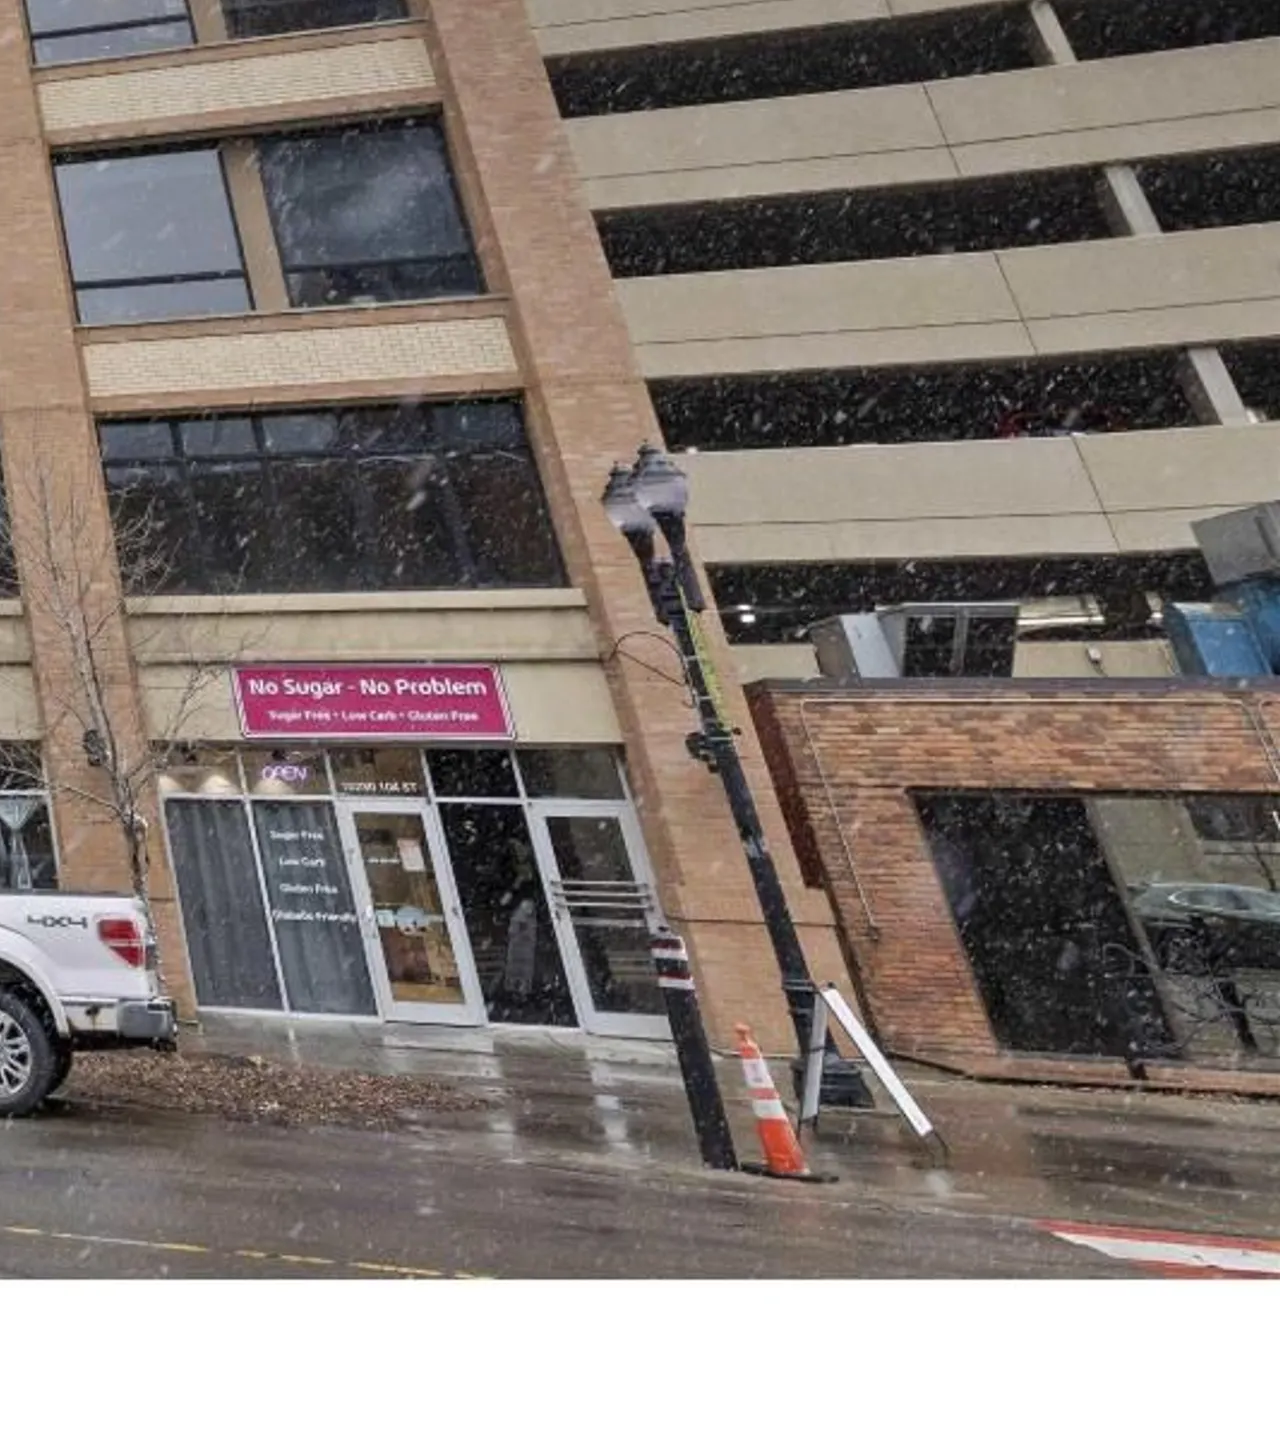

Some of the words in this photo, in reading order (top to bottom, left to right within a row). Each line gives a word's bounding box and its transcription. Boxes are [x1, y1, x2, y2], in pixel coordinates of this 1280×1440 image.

[248, 679, 279, 695] No
[284, 679, 343, 699] Sugar
[360, 679, 391, 695] No
[396, 677, 487, 695] Problem
[269, 710, 302, 722] Sugar
[304, 710, 331, 721] Free
[341, 710, 367, 721] Low
[369, 710, 397, 721] Carb
[407, 710, 448, 721] Gluten
[451, 710, 479, 721] Free
[262, 765, 308, 780] OPEN
